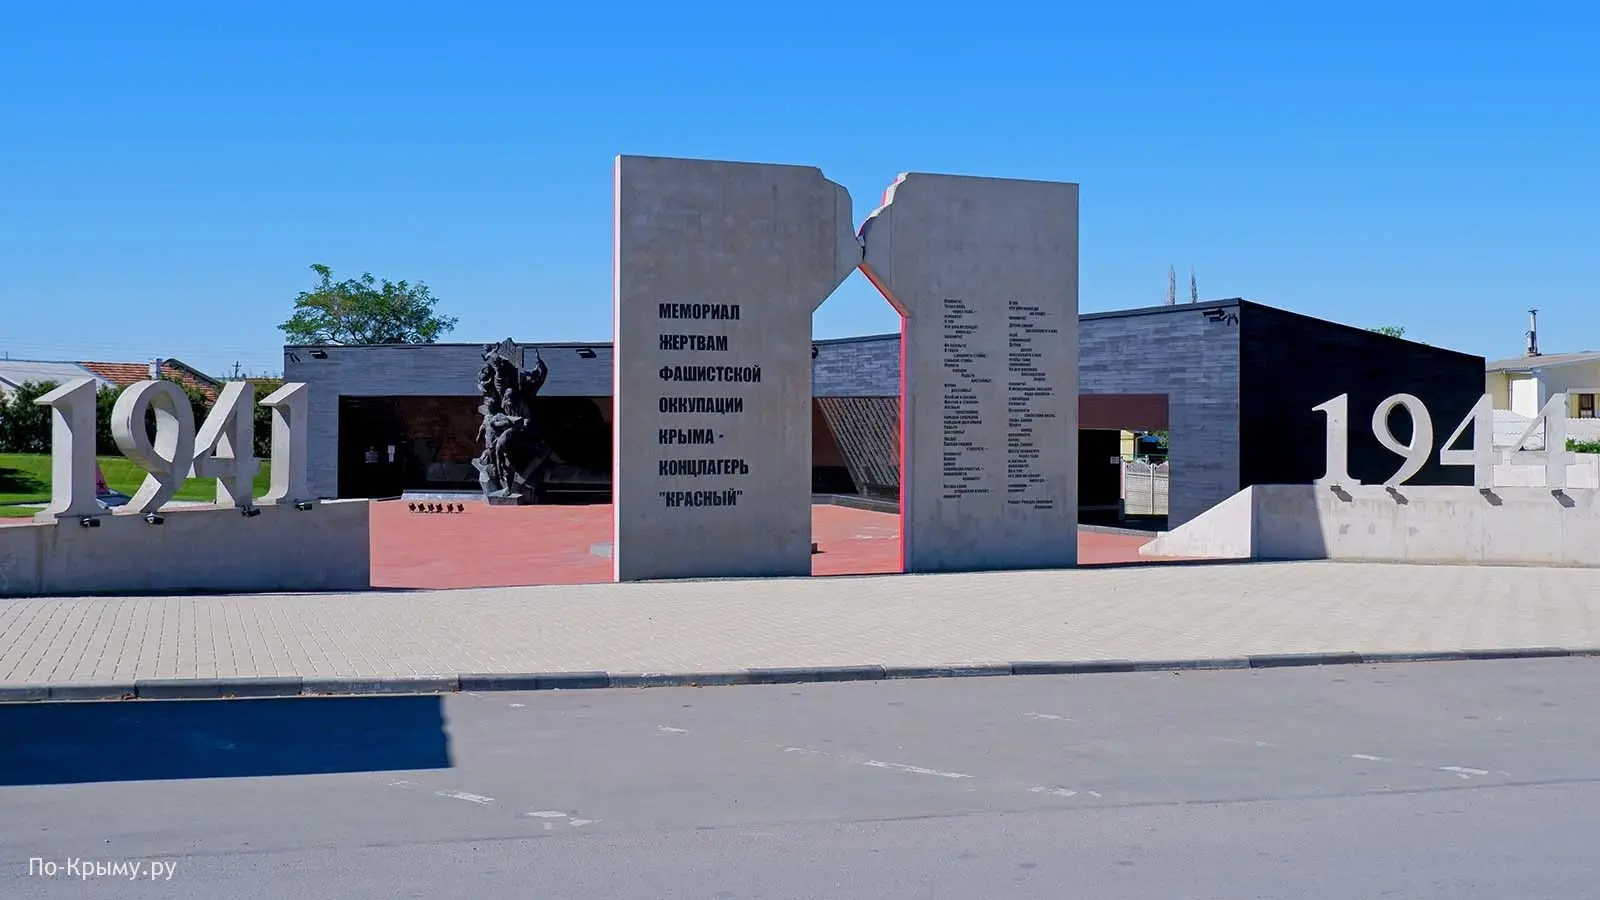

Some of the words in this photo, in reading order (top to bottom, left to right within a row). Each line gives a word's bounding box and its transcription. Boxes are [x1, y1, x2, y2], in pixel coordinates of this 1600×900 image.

[659, 303, 740, 320] МЕМОРИАЛ
[659, 335, 728, 351] ЖЕРТВАМ
[659, 364, 761, 382] ФАШИСТСКОЙ
[659, 397, 743, 414] ОККУПАЦИИ
[659, 429, 714, 444] КРЫМА
[1312, 393, 1576, 489] 1944
[33, 378, 309, 524] 1941
[659, 459, 749, 477] КОНЦЛАГЕРЬ
[659, 488, 743, 507] "КРАСНЫЙ"
